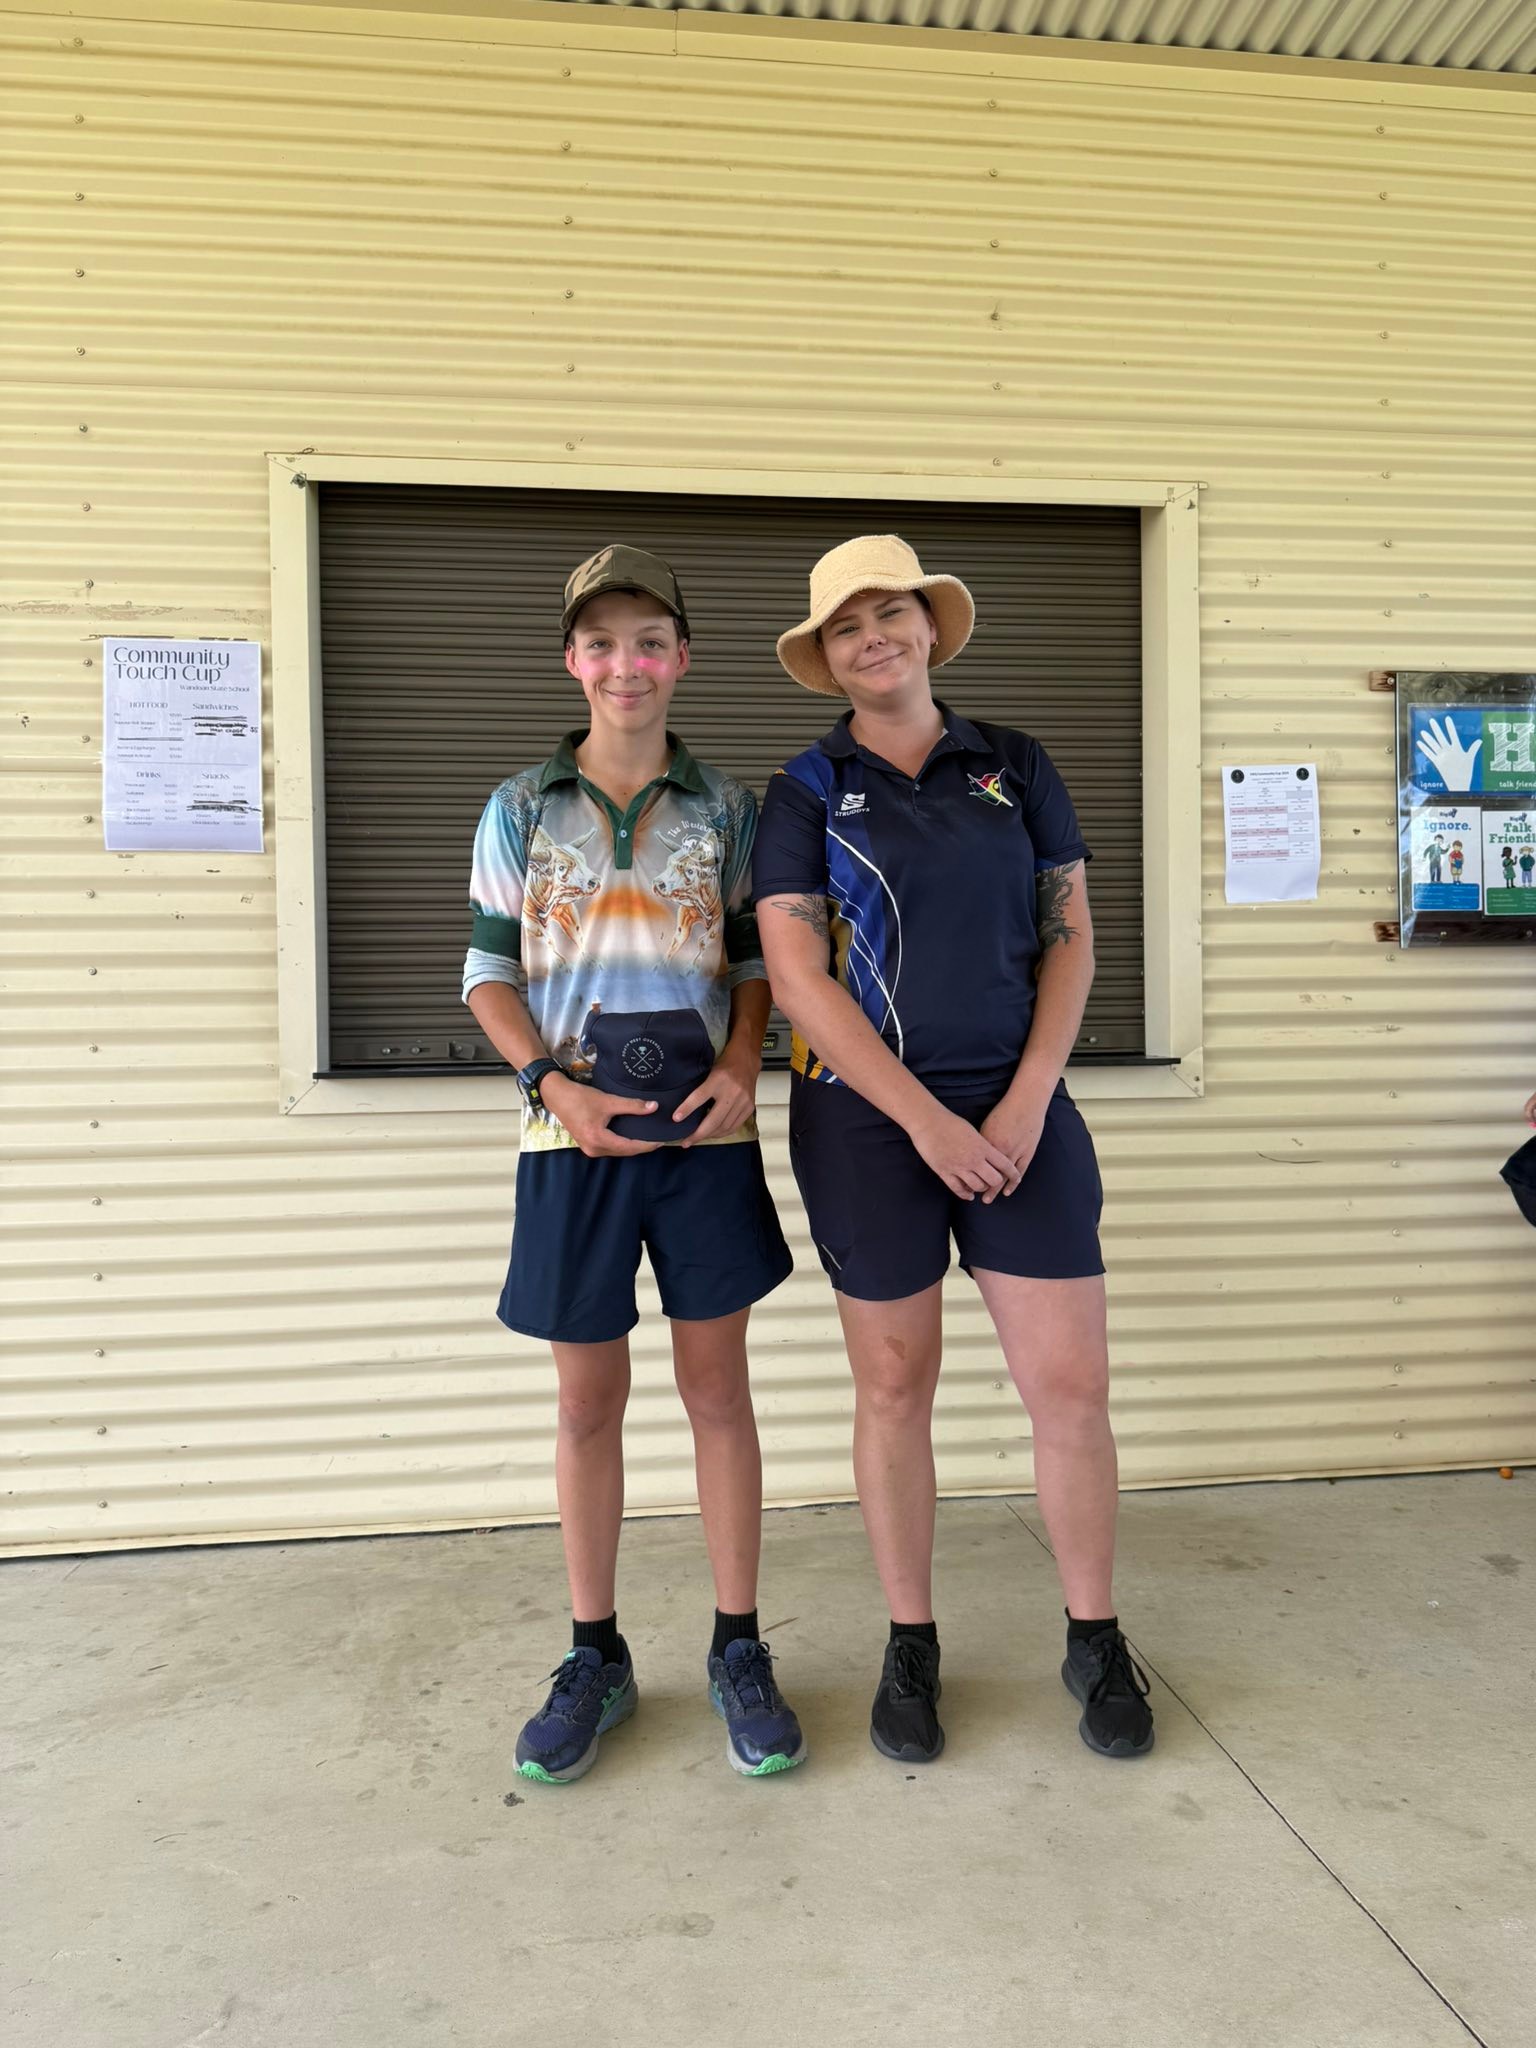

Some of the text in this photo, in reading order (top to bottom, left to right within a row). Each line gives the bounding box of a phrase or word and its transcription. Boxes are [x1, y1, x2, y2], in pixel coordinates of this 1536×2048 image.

[113, 646, 230, 670] Community
[113, 663, 222, 684] Touch Cup
[192, 702, 239, 711] Sandwiches
[136, 770, 161, 778] Drinks
[202, 772, 230, 780] Snacks
[1420, 780, 1444, 790] ignore
[1499, 780, 1514, 788] talk
[834, 807, 870, 817] STRUDDYS
[1423, 820, 1472, 832] Ignore.
[1504, 822, 1532, 832] Talk
[622, 1061, 664, 1079] COMMUNITY CUP
